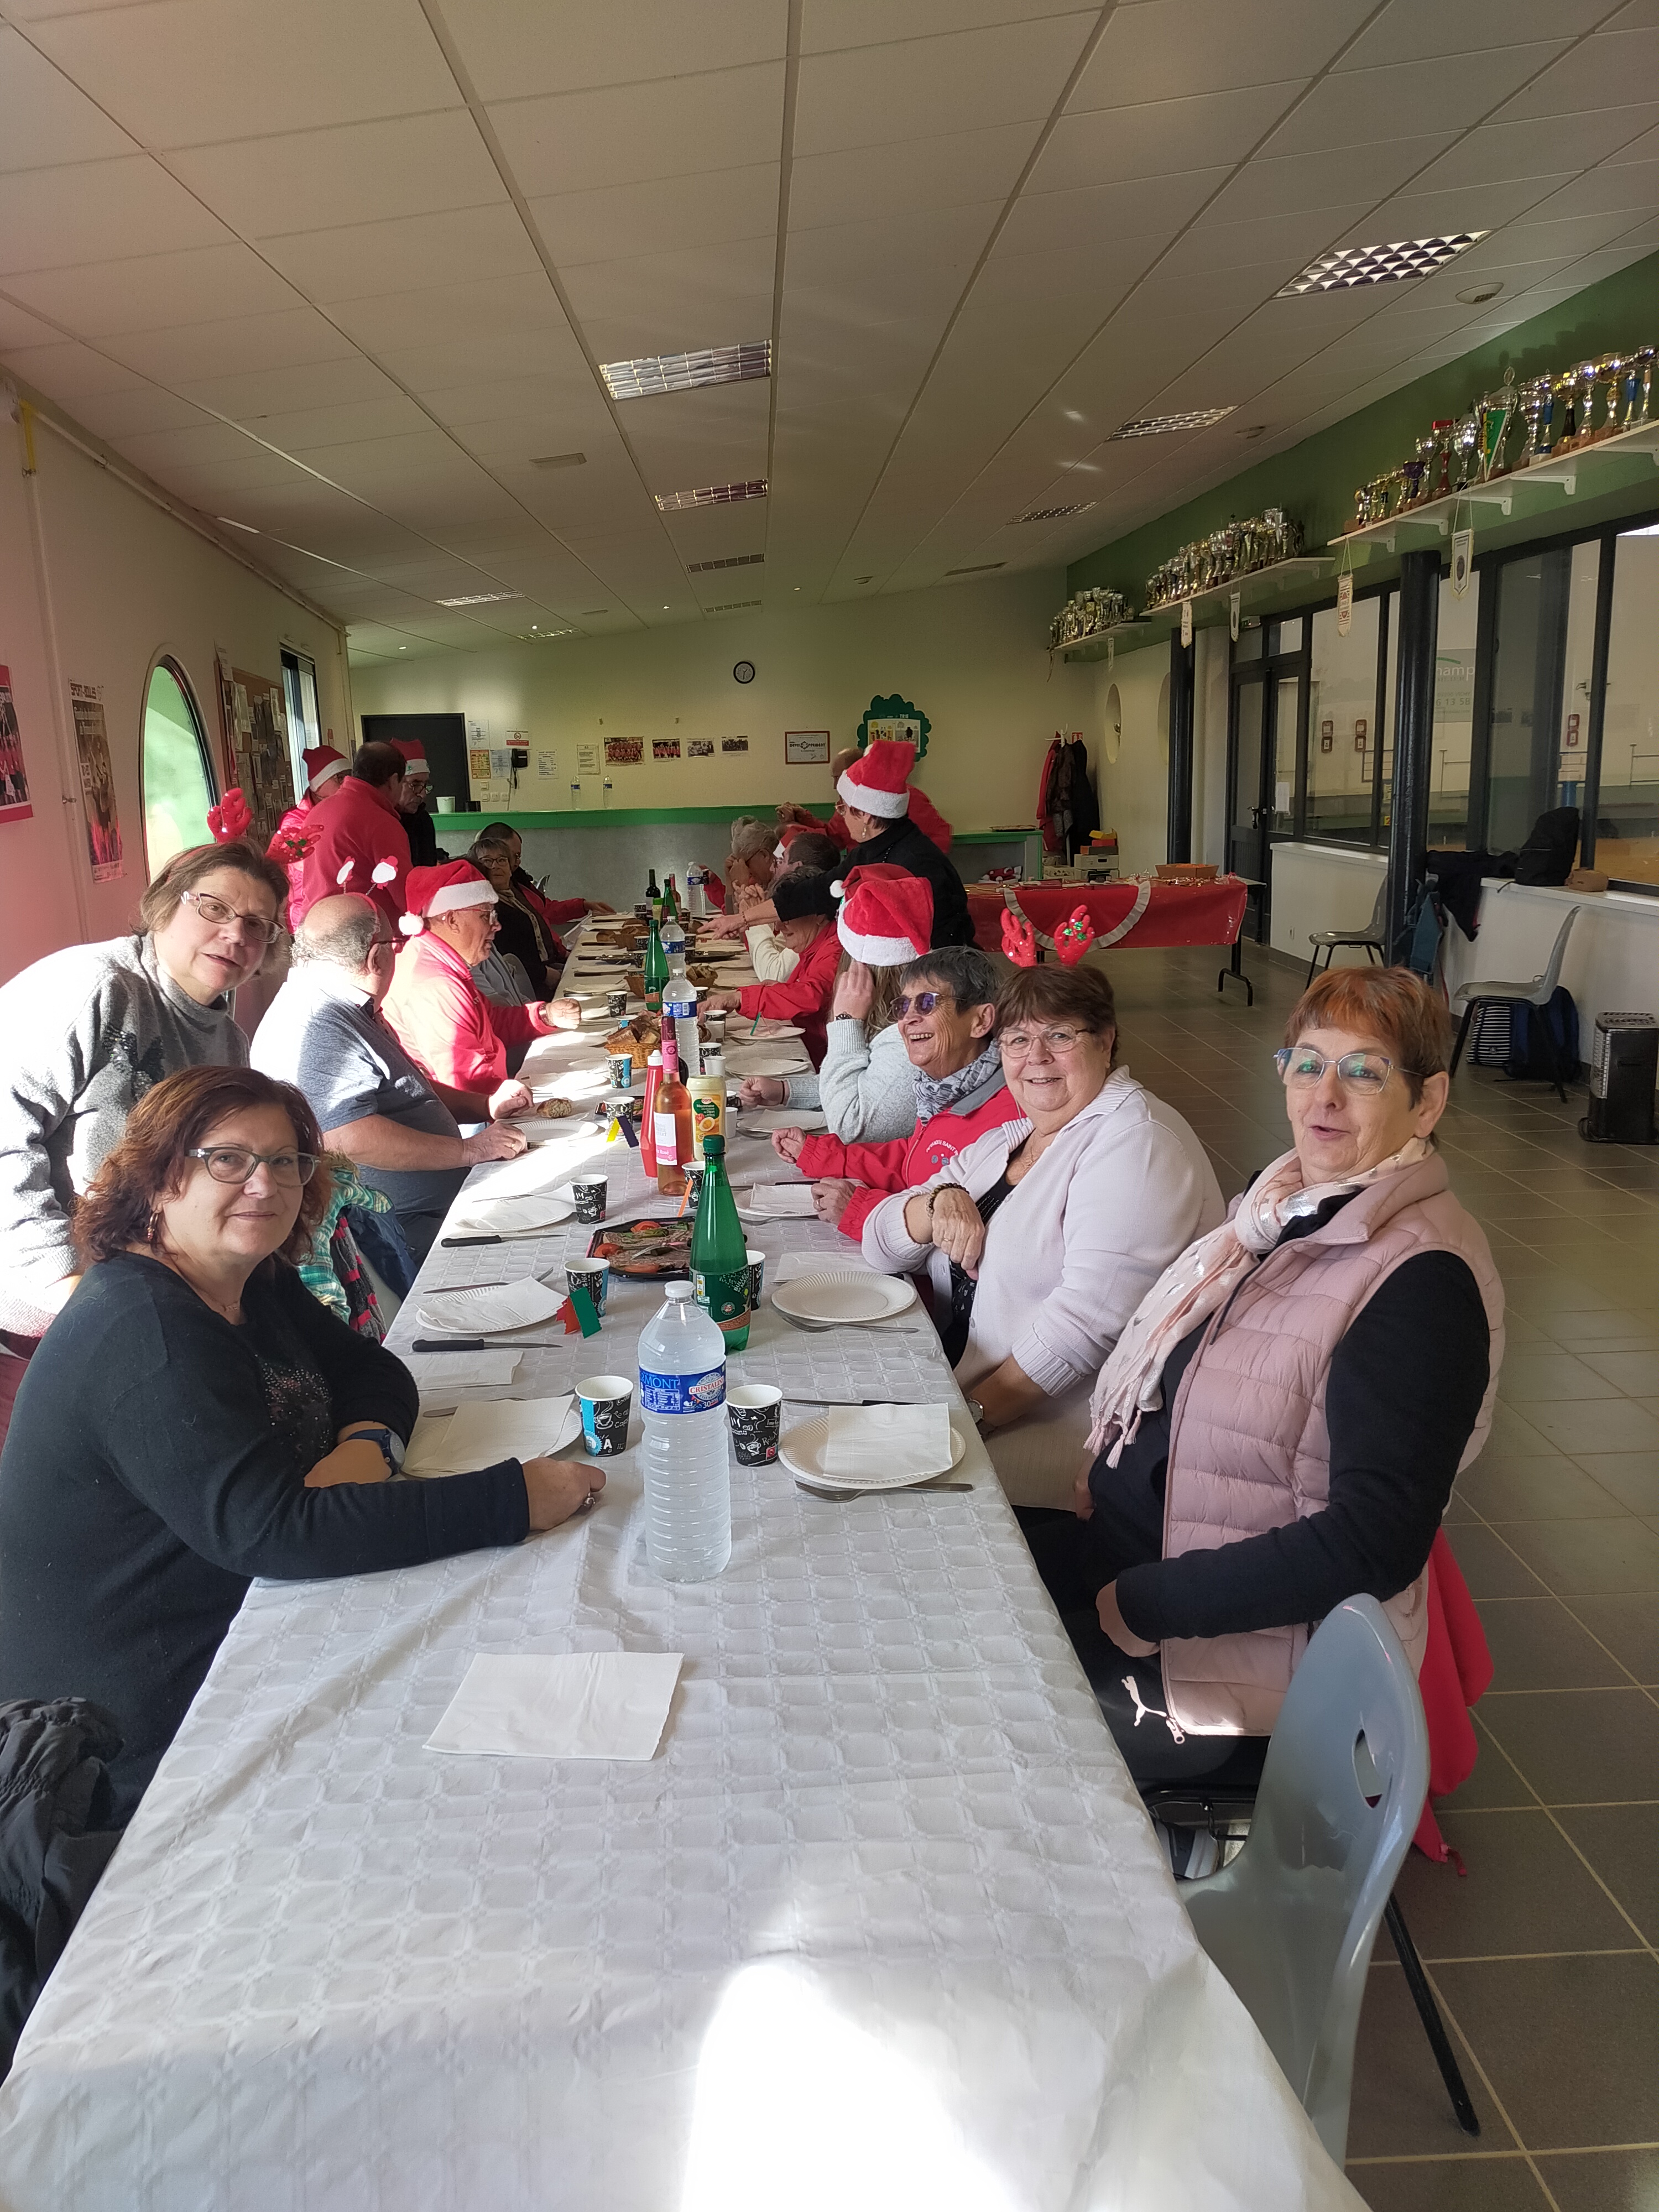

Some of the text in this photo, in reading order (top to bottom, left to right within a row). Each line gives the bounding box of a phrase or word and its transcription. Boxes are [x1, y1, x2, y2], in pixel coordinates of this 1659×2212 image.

[942, 1140, 956, 1151] SAINT
[641, 1373, 679, 1389] RMONT
[690, 1378, 723, 1394] CRISTALIN
[703, 1400, 711, 1408] 30
